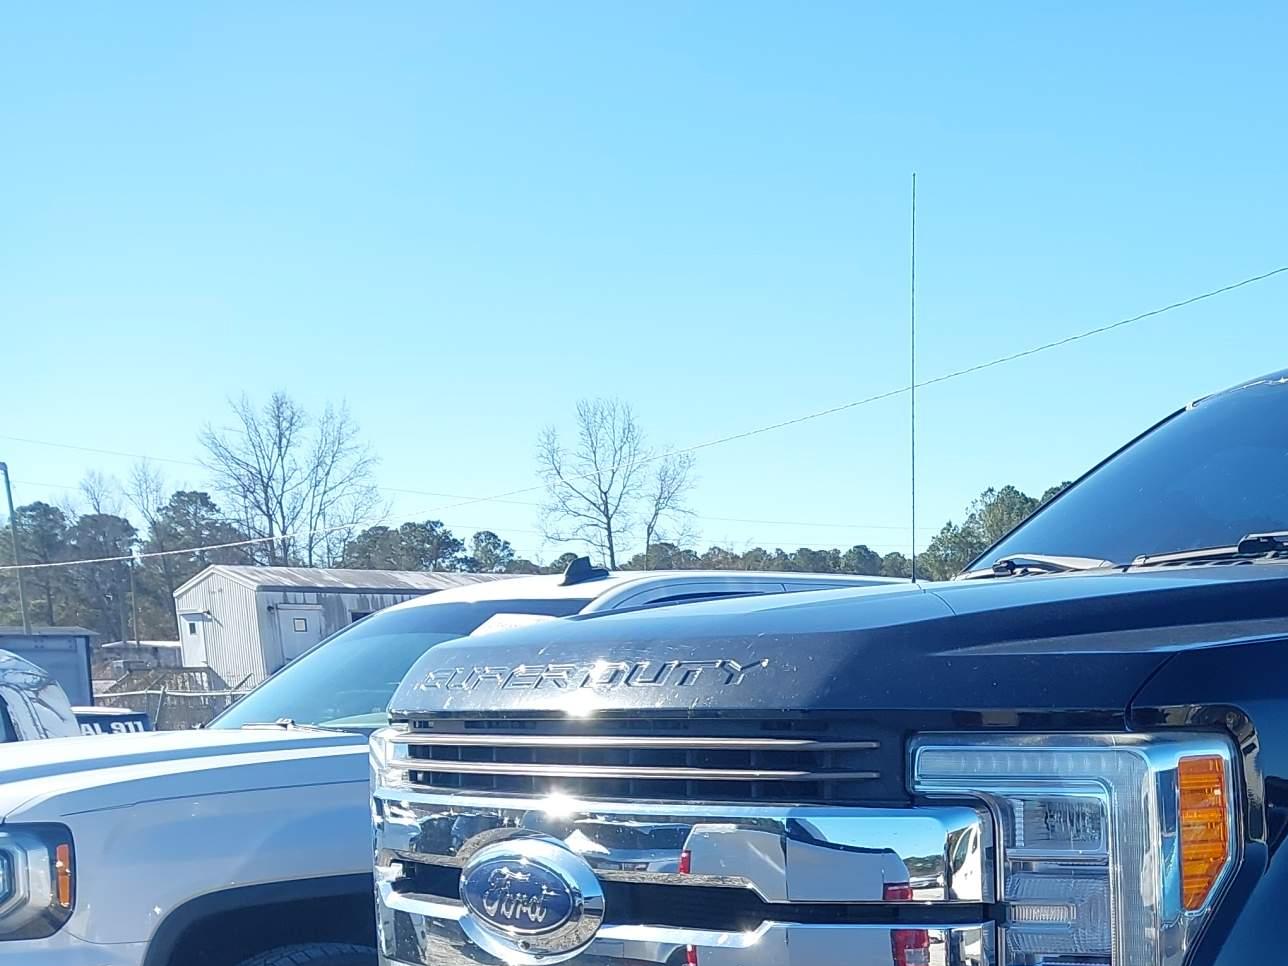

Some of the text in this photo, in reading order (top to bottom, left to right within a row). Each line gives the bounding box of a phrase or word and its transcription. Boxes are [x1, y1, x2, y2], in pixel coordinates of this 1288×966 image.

[415, 659, 770, 691] SUPER DUTY
[483, 867, 560, 922] Ford
